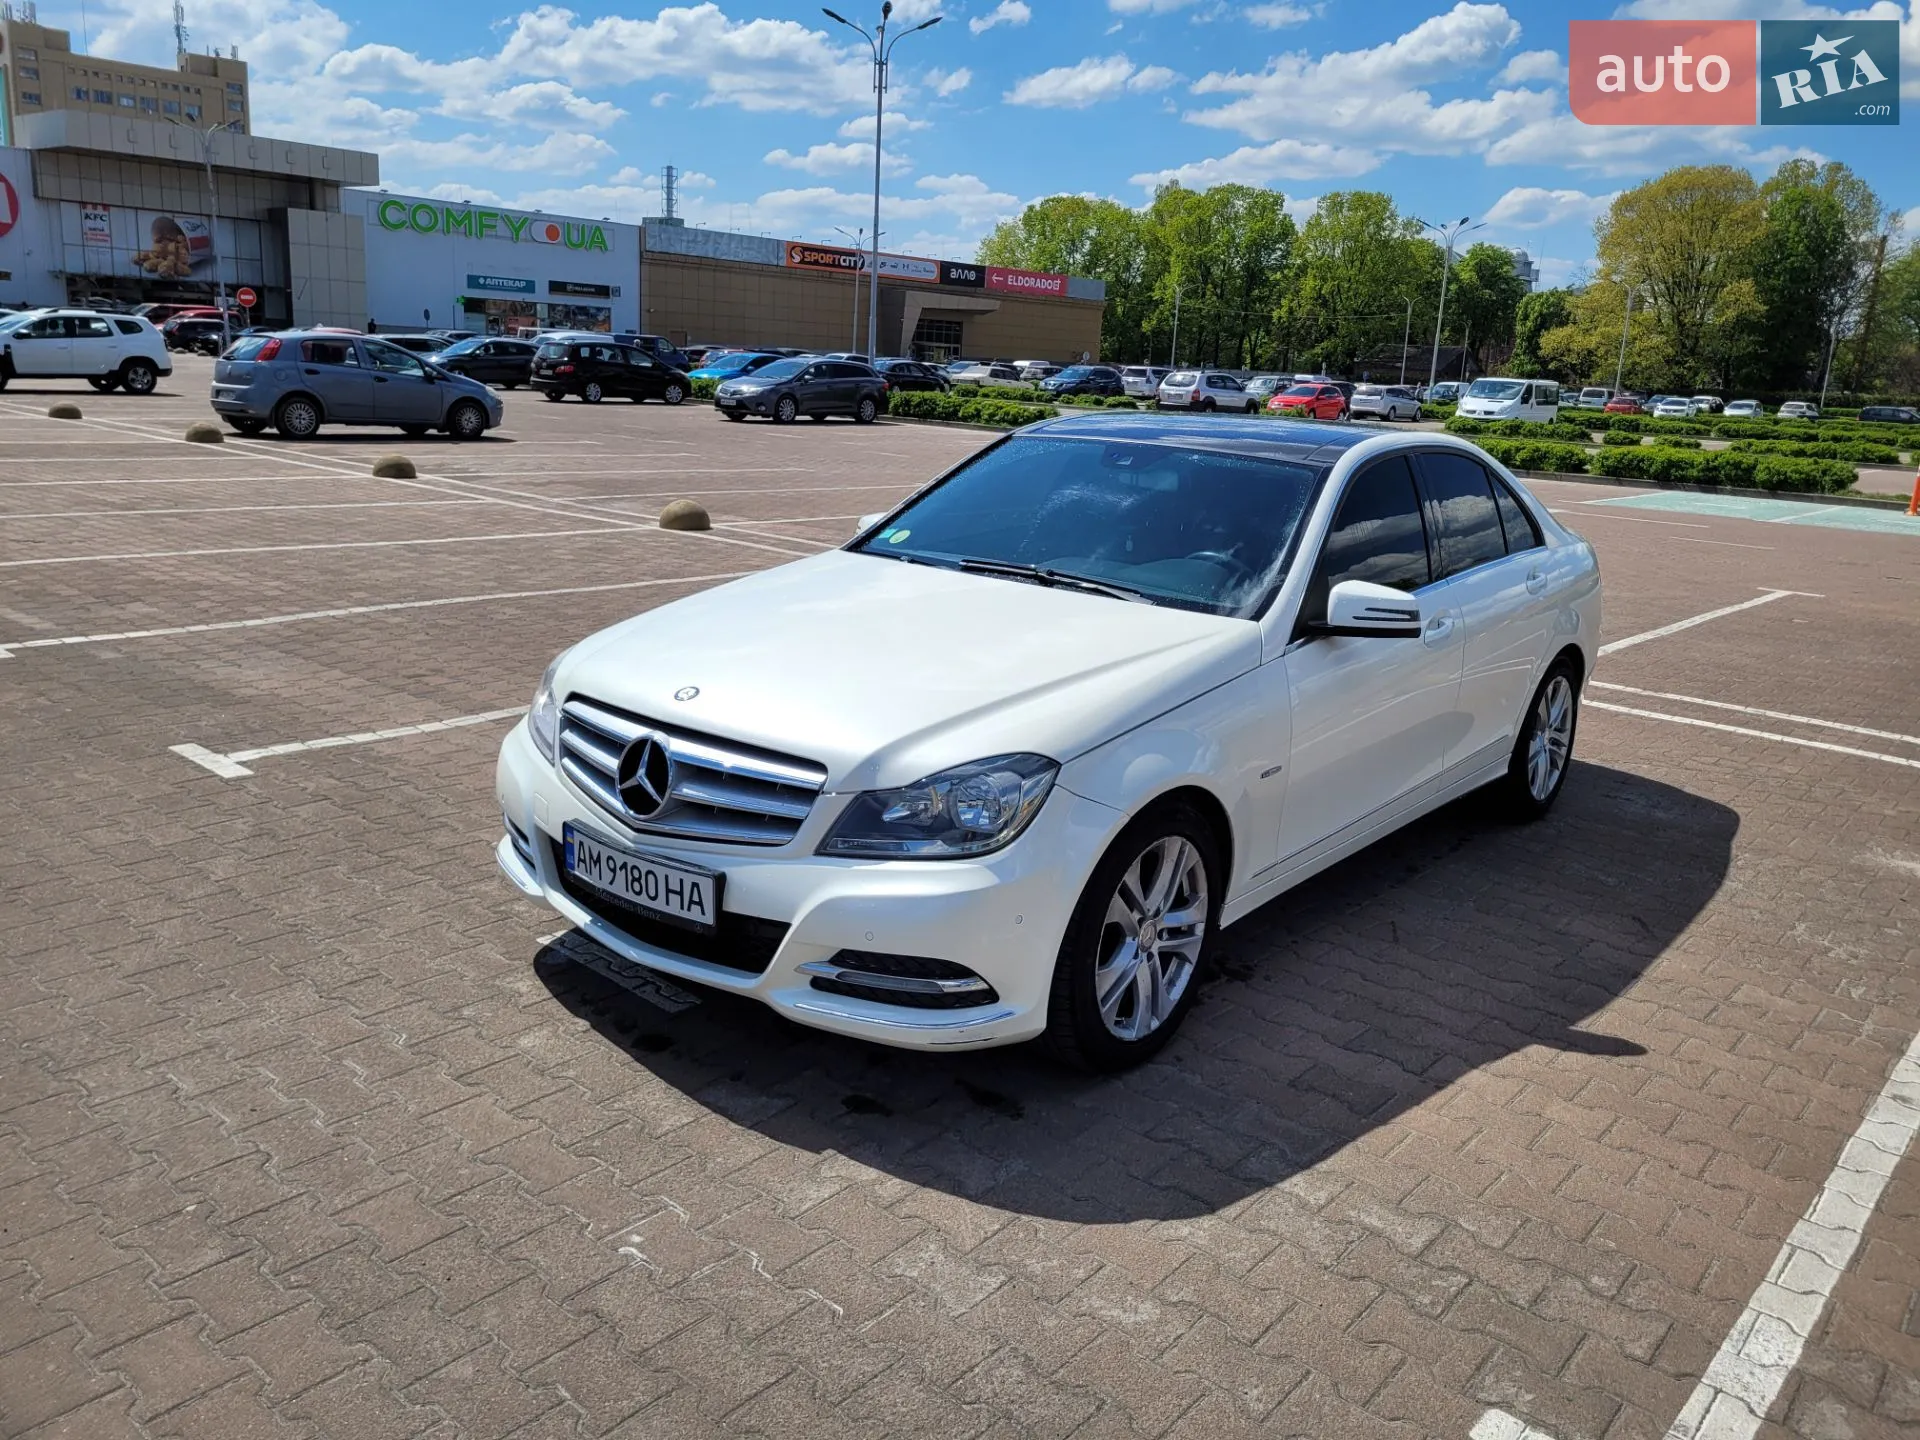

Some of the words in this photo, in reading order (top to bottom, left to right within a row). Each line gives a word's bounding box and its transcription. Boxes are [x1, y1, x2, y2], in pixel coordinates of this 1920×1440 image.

[84, 212, 108, 222] KFC
[378, 199, 530, 243] COMFY
[564, 221, 609, 252] UA
[803, 251, 864, 268] SPORTCITY
[606, 855, 659, 901] 9180
